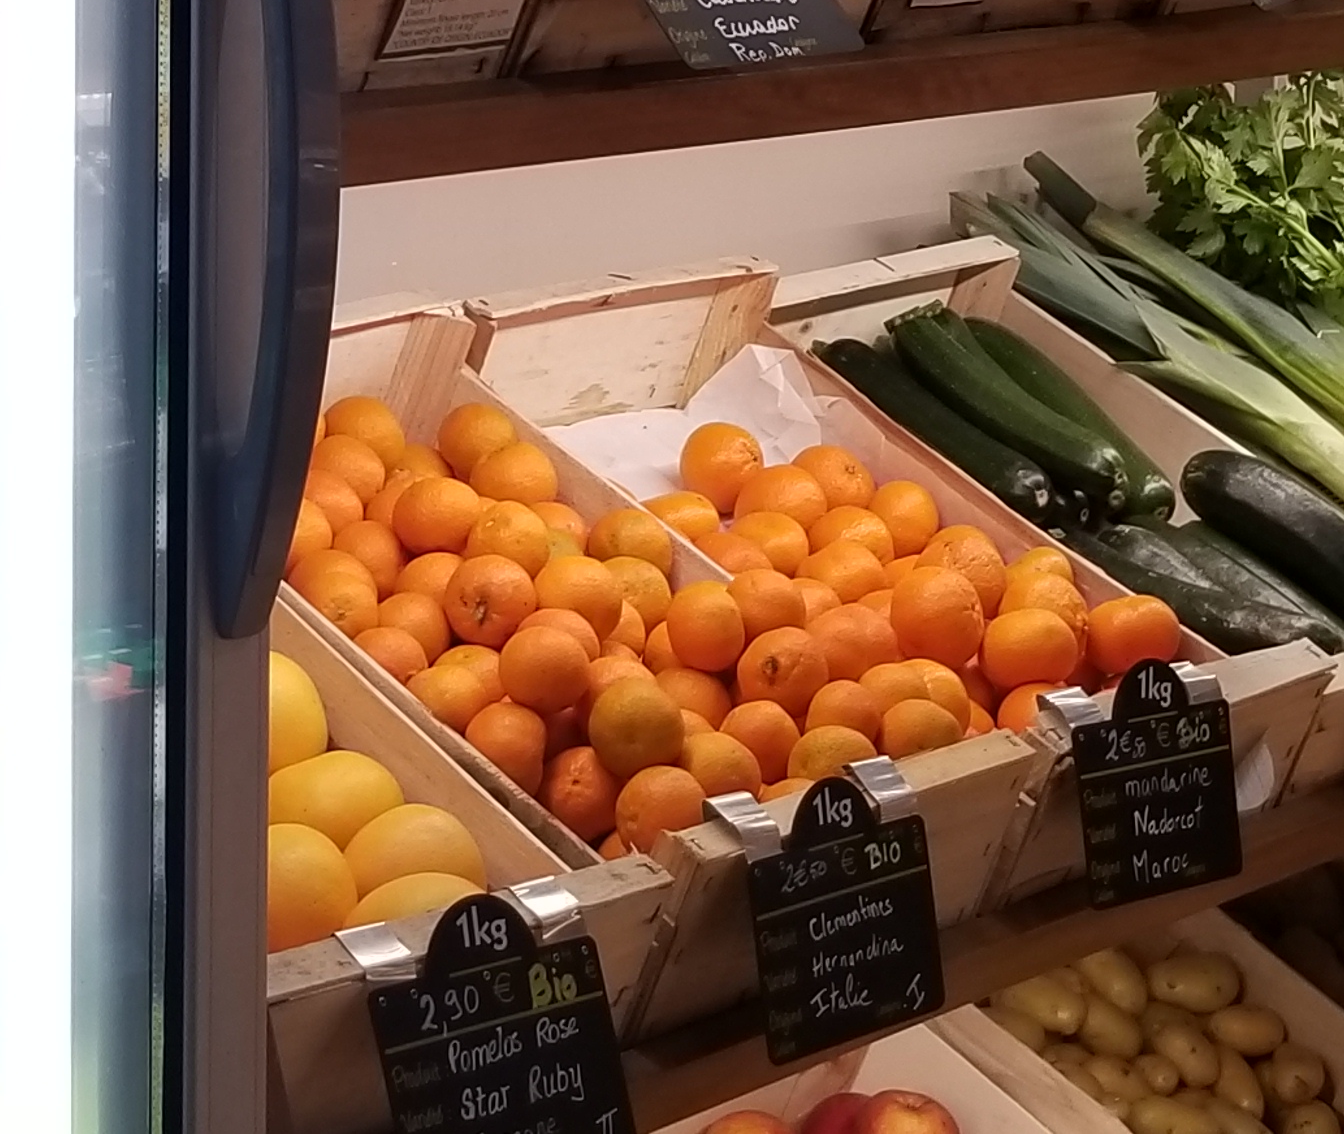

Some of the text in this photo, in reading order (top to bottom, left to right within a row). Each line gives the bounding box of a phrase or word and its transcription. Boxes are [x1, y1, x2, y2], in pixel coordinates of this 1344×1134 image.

[714, 15, 800, 38] Ecuador
[1137, 665, 1173, 708] 1kg
[1176, 713, 1211, 749] Bio
[1124, 764, 1213, 797] mandarine
[812, 787, 854, 828] 1kg
[1134, 795, 1204, 837] Nadorcot
[864, 840, 902, 871] BIO
[1132, 849, 1190, 884] Maroc
[456, 905, 508, 950] 1kg
[809, 895, 894, 942] Clementines
[812, 934, 904, 978] Hernandina
[420, 962, 577, 1037] 2,90 Bio
[809, 972, 873, 1018] Italie
[447, 1016, 579, 1074] Pomelos Rose
[460, 1063, 585, 1120] Star Ruby
